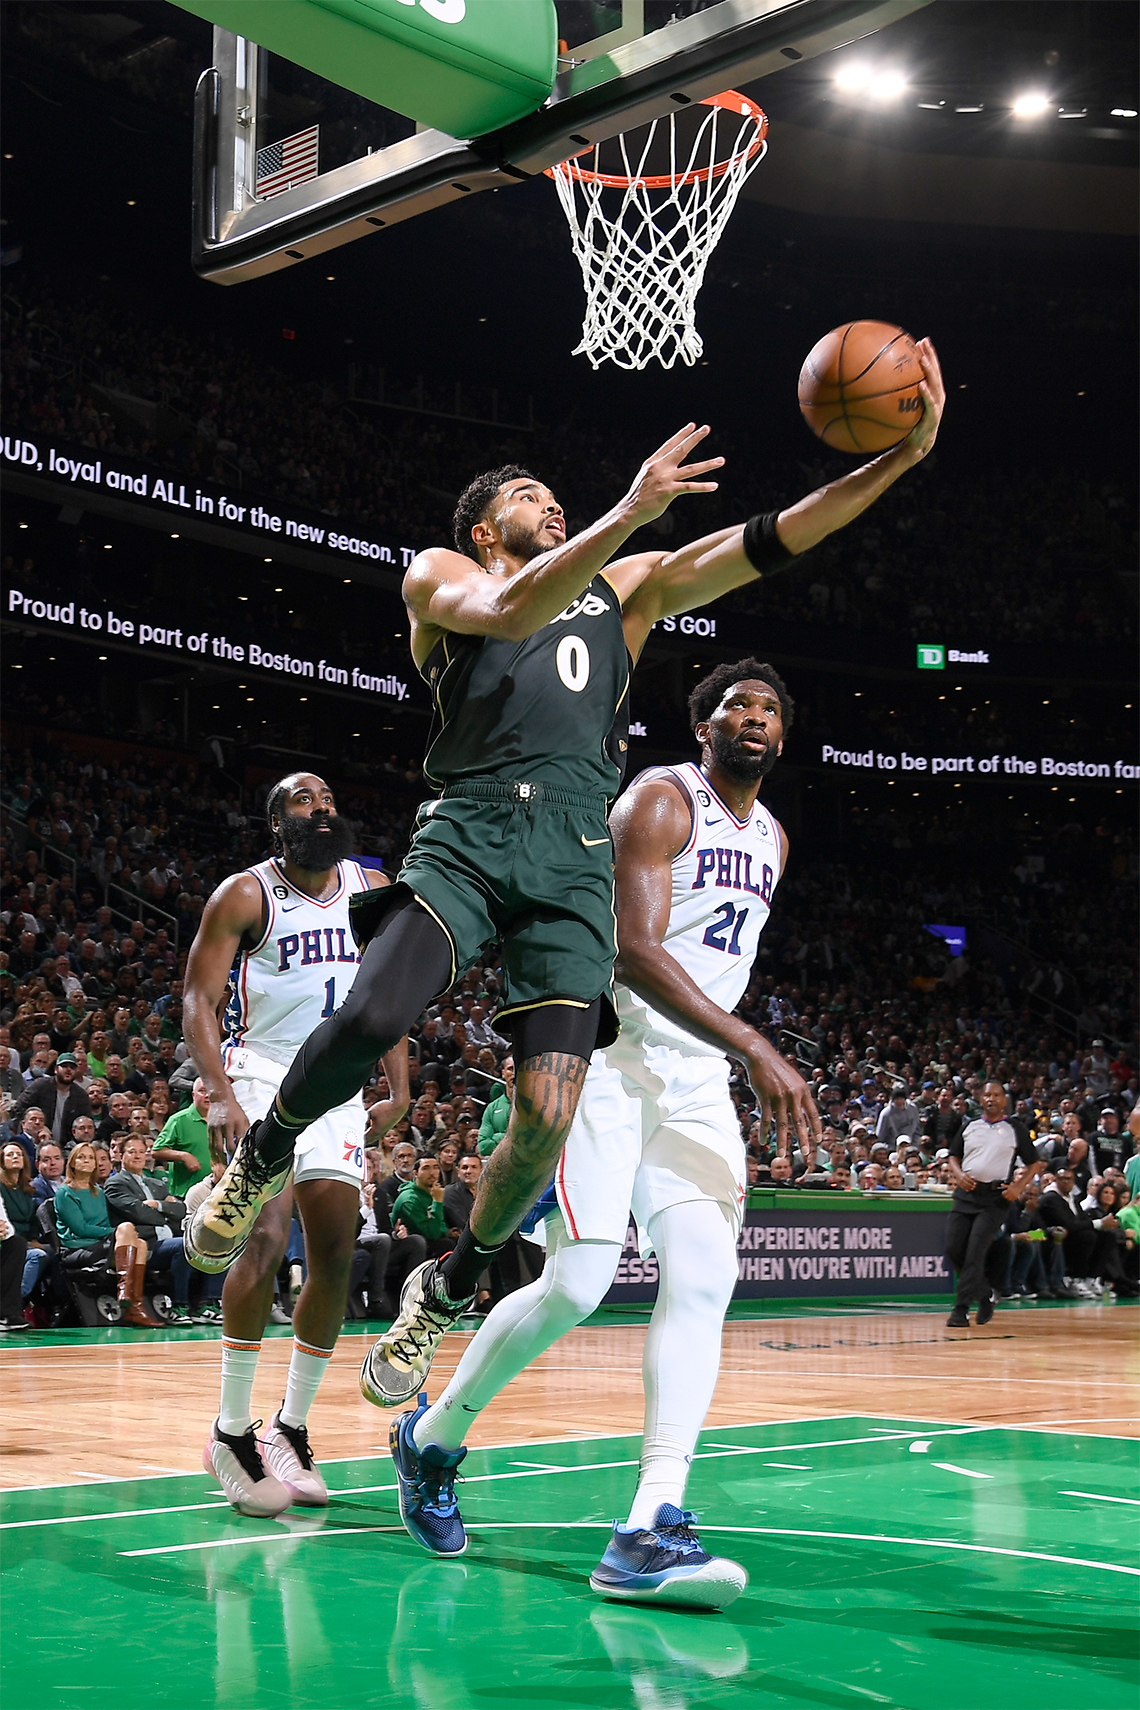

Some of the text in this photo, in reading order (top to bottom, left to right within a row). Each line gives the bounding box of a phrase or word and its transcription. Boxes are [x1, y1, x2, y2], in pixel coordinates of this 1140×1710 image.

[0, 435, 43, 471] UD,
[48, 448, 102, 484] loyal
[105, 470, 148, 496] and
[151, 478, 192, 509] ALL
[195, 489, 214, 515] in
[217, 496, 247, 522] for
[249, 506, 282, 532] the
[285, 519, 325, 544] new
[327, 532, 397, 564] season.
[680, 615, 717, 638] GO!
[8, 589, 411, 702] Proud to be part of the Boston fan family.
[918, 647, 990, 666] TD Bank
[555, 634, 591, 693] 0
[822, 744, 874, 768] Proud
[876, 753, 898, 770] to
[901, 752, 928, 771] be
[931, 756, 975, 775] part
[978, 754, 1000, 773] of
[1002, 755, 1038, 775] the
[1041, 757, 1111, 778] Boston
[274, 886, 288, 900] 6
[702, 901, 749, 956] 21
[277, 927, 363, 973] PHIL
[736, 1226, 893, 1251] XPERIENCE MORE
[788, 1256, 851, 1280] YOU'RE
[853, 1256, 897, 1279] WITH
[899, 1255, 950, 1278] AMEX.
